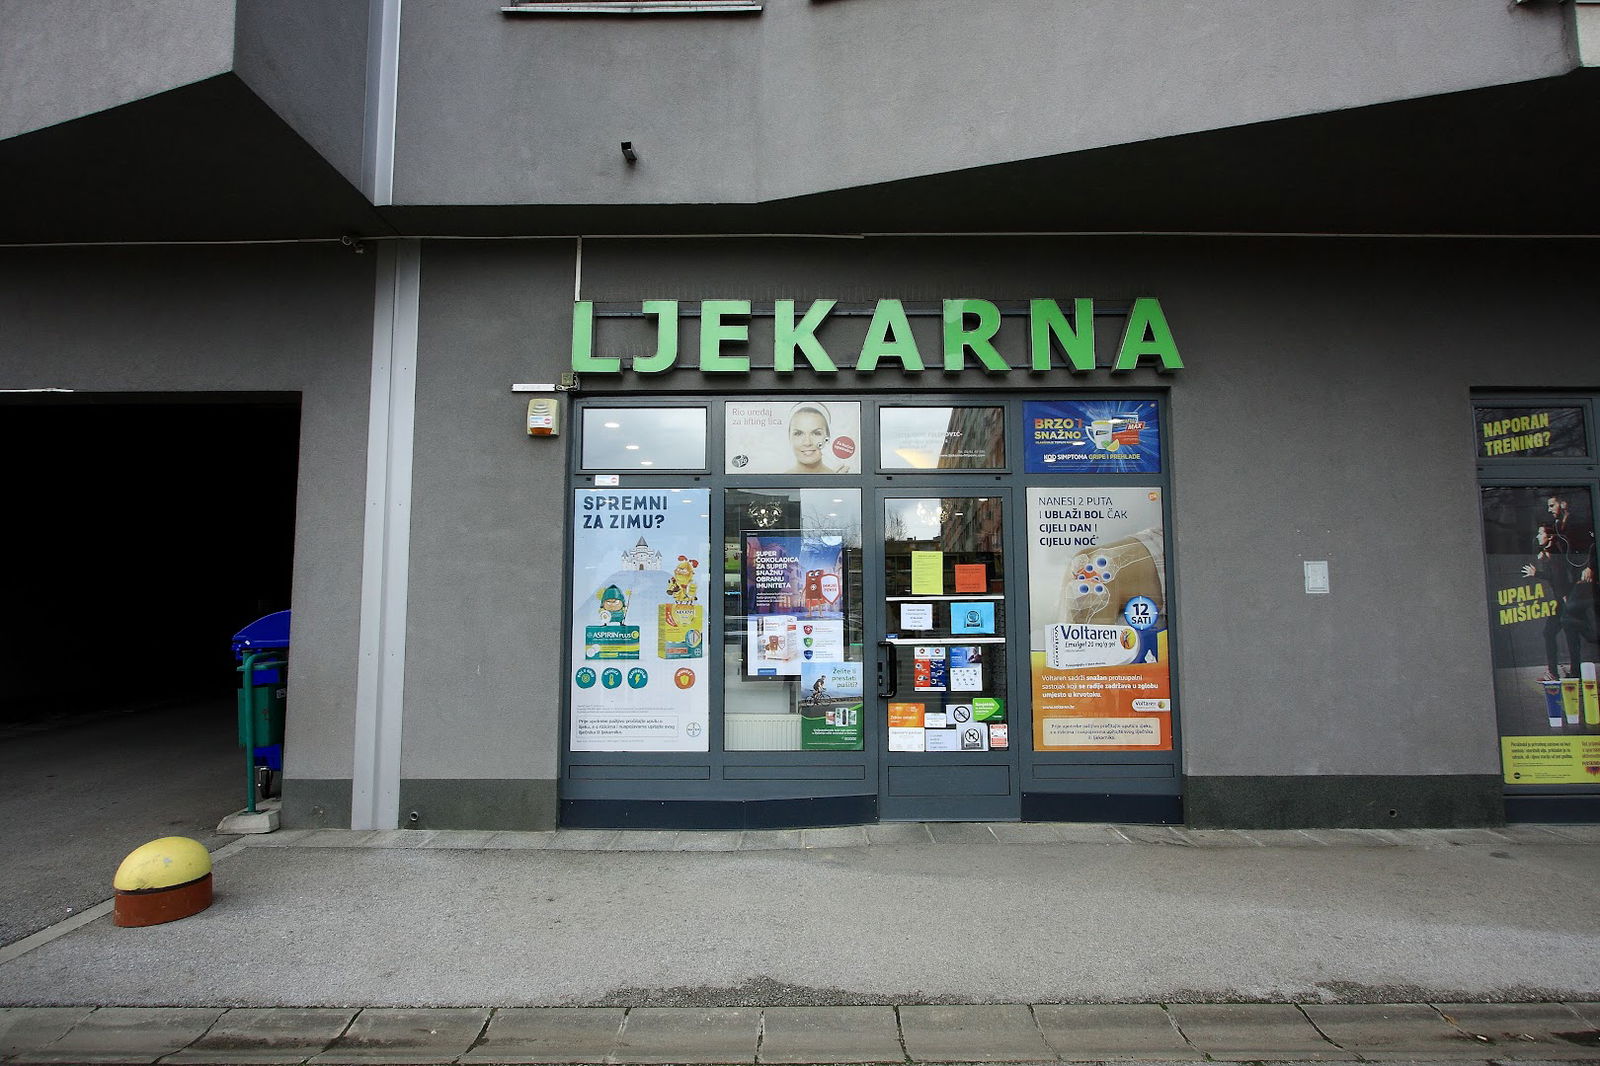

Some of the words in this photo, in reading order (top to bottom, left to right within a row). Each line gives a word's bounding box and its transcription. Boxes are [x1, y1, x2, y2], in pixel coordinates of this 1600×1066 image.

[571, 297, 1184, 373] LJEKARNA
[732, 408, 745, 416] Rio
[1034, 418, 1074, 429] BRZO
[1483, 413, 1549, 438] NAPORAN
[1034, 429, 1082, 440] SNAŽNO
[1484, 431, 1551, 456] TRENING?
[583, 495, 668, 511] SPREMNI
[1038, 497, 1076, 506] NANESI
[1078, 497, 1084, 506] 2
[1086, 497, 1113, 506] PUTA
[1044, 508, 1081, 519] UBLAŽI
[1084, 510, 1104, 519] BOL
[1107, 507, 1128, 519] ČAK
[583, 514, 604, 529] ZA
[609, 514, 666, 529] ZIMU?
[1039, 523, 1067, 534] CIJELI
[1069, 523, 1091, 533] DAN
[1039, 537, 1071, 547] CIJELU
[1497, 583, 1544, 606] UPALA
[1132, 603, 1149, 616] 12
[1500, 600, 1557, 625] MIŠIĆA?
[1131, 616, 1152, 625] SATI
[592, 631, 619, 639] ASPIRIN
[1060, 625, 1117, 640] Voltaren
